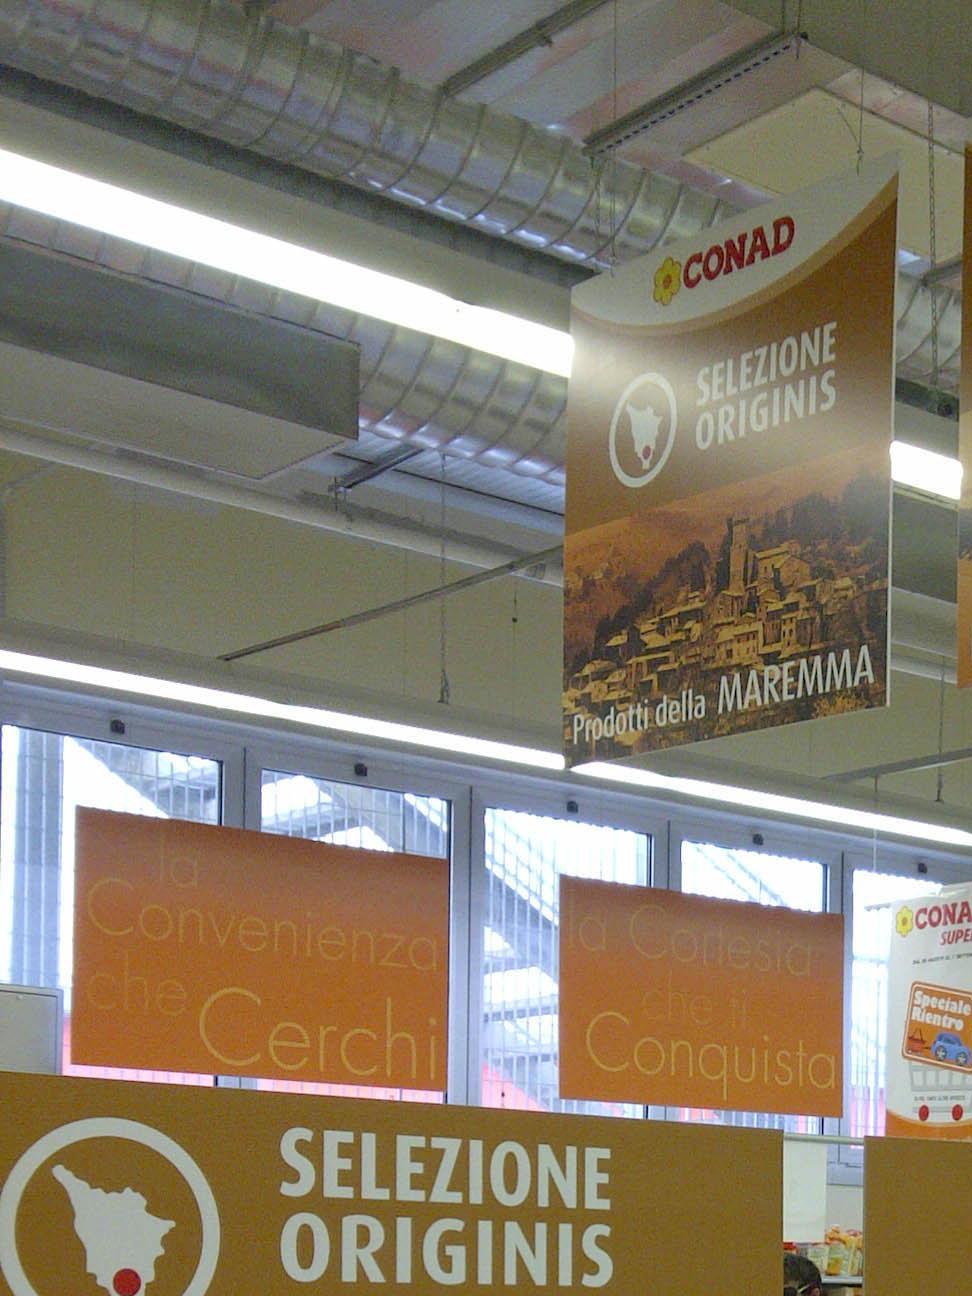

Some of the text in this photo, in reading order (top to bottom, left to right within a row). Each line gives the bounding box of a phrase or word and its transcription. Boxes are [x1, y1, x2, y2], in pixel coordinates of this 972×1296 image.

[682, 214, 796, 292] CONAD
[696, 321, 837, 407] SELEZIONE
[696, 369, 837, 454] ORIGINIS
[572, 643, 876, 746] Prodotti della MAREMMA
[86, 877, 440, 972] Convenienza
[198, 987, 438, 1081] Cerchi
[911, 1007, 965, 1031] Rientro
[913, 990, 972, 1017] Speciale
[586, 1010, 837, 1101] Conquista
[279, 1126, 611, 1210] SELEZIONE
[279, 1213, 614, 1288] ORIGINIS
